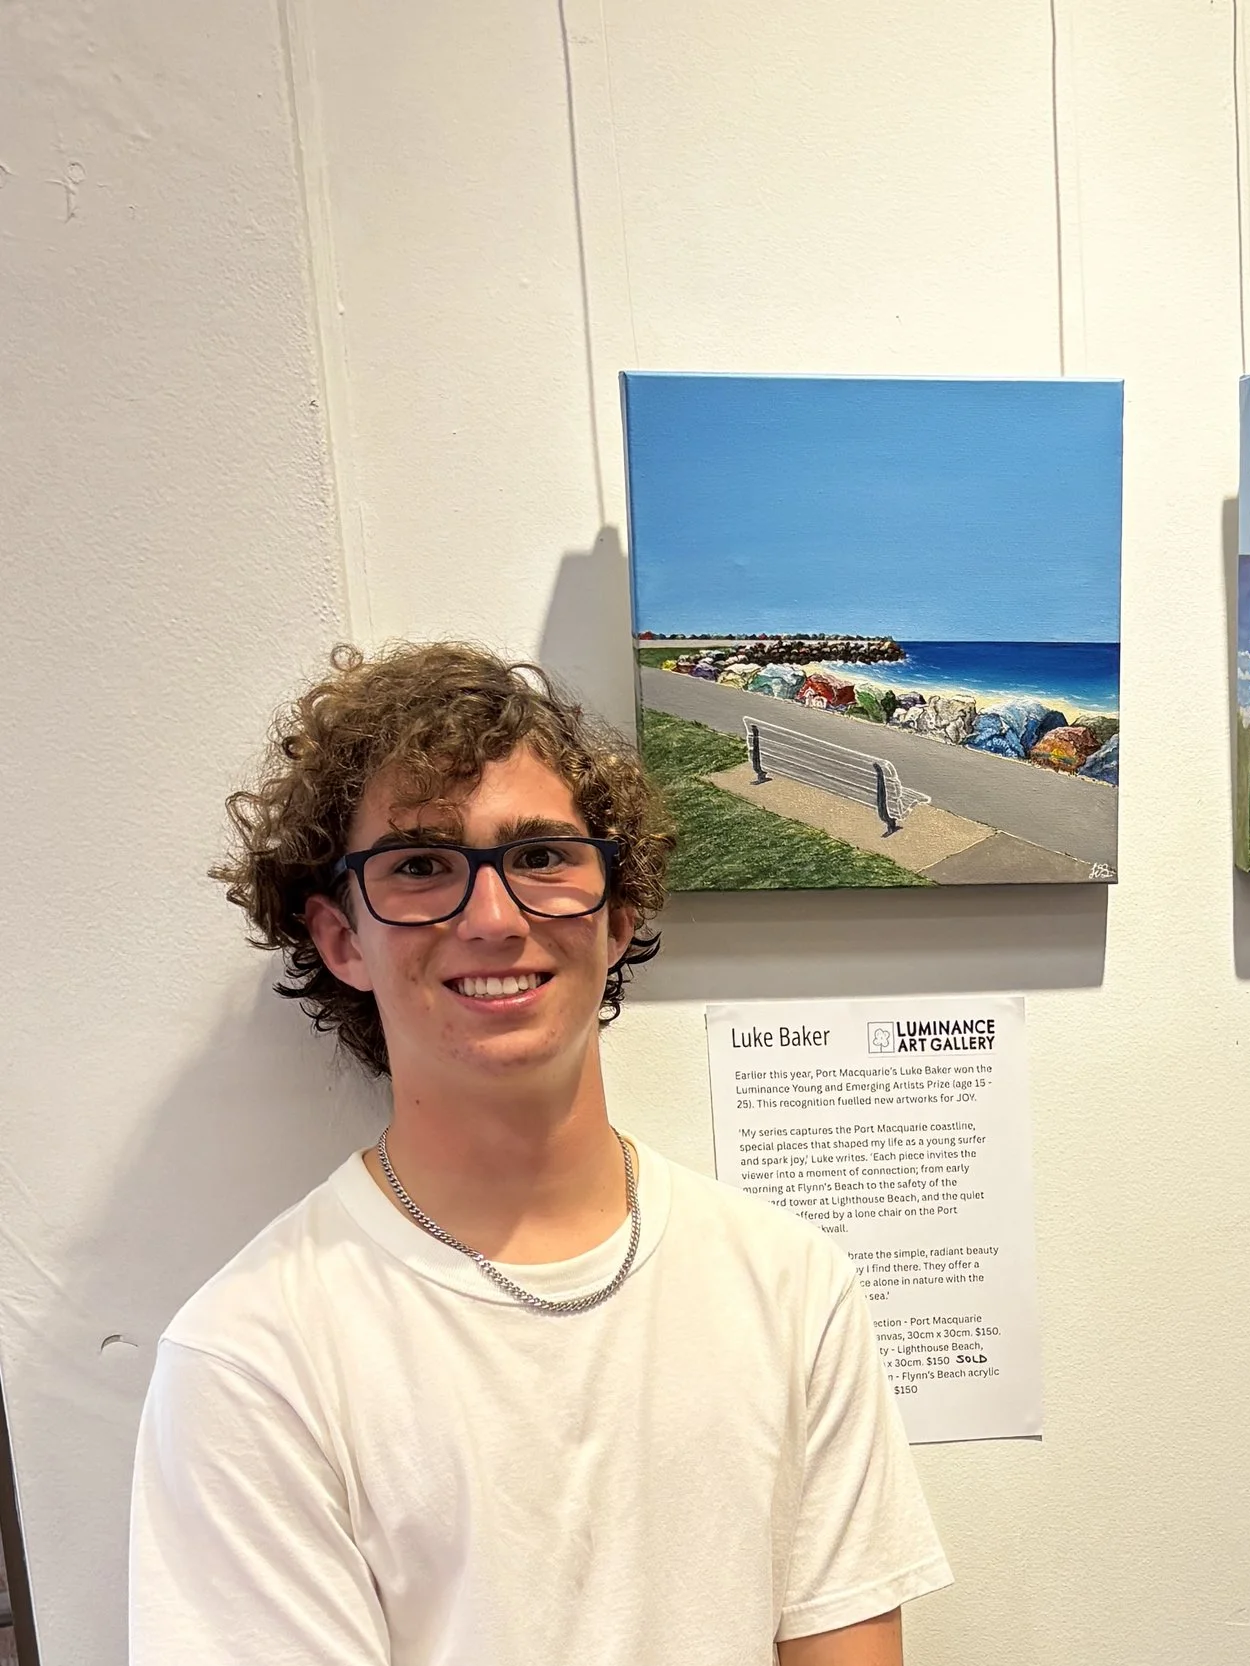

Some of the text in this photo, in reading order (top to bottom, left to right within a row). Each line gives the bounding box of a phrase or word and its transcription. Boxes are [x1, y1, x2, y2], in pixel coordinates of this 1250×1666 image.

[896, 1019, 995, 1037] LUMINANCE
[731, 1025, 830, 1048] Luke Baker
[897, 1036, 995, 1052] ART GALLERY
[735, 1064, 992, 1080] Earlier this year, Port Luke Baker won the
[735, 1079, 972, 1094] Luminance Young and Emerging Artists Prize (age
[756, 1098, 777, 1108] This
[779, 1098, 835, 1109] recognition
[837, 1096, 871, 1105] fuelled
[896, 1094, 938, 1104] artworks
[940, 1093, 954, 1102] for
[956, 1093, 976, 1102] JOY.
[758, 1121, 975, 1136] series captures the Port Macquarie coastline,
[739, 1134, 986, 1153] special places that shaped life young surfer
[740, 1149, 976, 1167] and spark Luke writes. piece invites the
[741, 1163, 969, 1180] viewer into moment connection; from early
[742, 1178, 957, 1195] morning Beach the safety the
[789, 1198, 817, 1206] tower
[831, 1195, 885, 1207] Lighthouse
[887, 1193, 919, 1203] Beach,
[921, 1192, 939, 1201] and
[941, 1192, 958, 1200] the
[959, 1190, 984, 1201] quiet
[854, 1206, 957, 1218] lone chair the Port
[875, 1246, 999, 1259] the simple, radiant beauty
[871, 1263, 890, 1272] find
[893, 1263, 921, 1272] there.
[923, 1261, 946, 1272] They
[948, 1260, 972, 1269] offer
[872, 1278, 899, 1286] alone
[912, 1276, 943, 1284] nature
[945, 1274, 966, 1283] with
[968, 1273, 984, 1282] the
[910, 1314, 982, 1326] Port Macquarie
[907, 1327, 1001, 1339] 30cm 30cm. $150.
[897, 1344, 949, 1355] Lighthouse
[951, 1341, 983, 1351] Beach,
[894, 1356, 950, 1367] 30cm. $150
[955, 1354, 987, 1363] SOLD
[937, 1367, 999, 1378] Beach acrylic
[894, 1385, 918, 1395] $150
